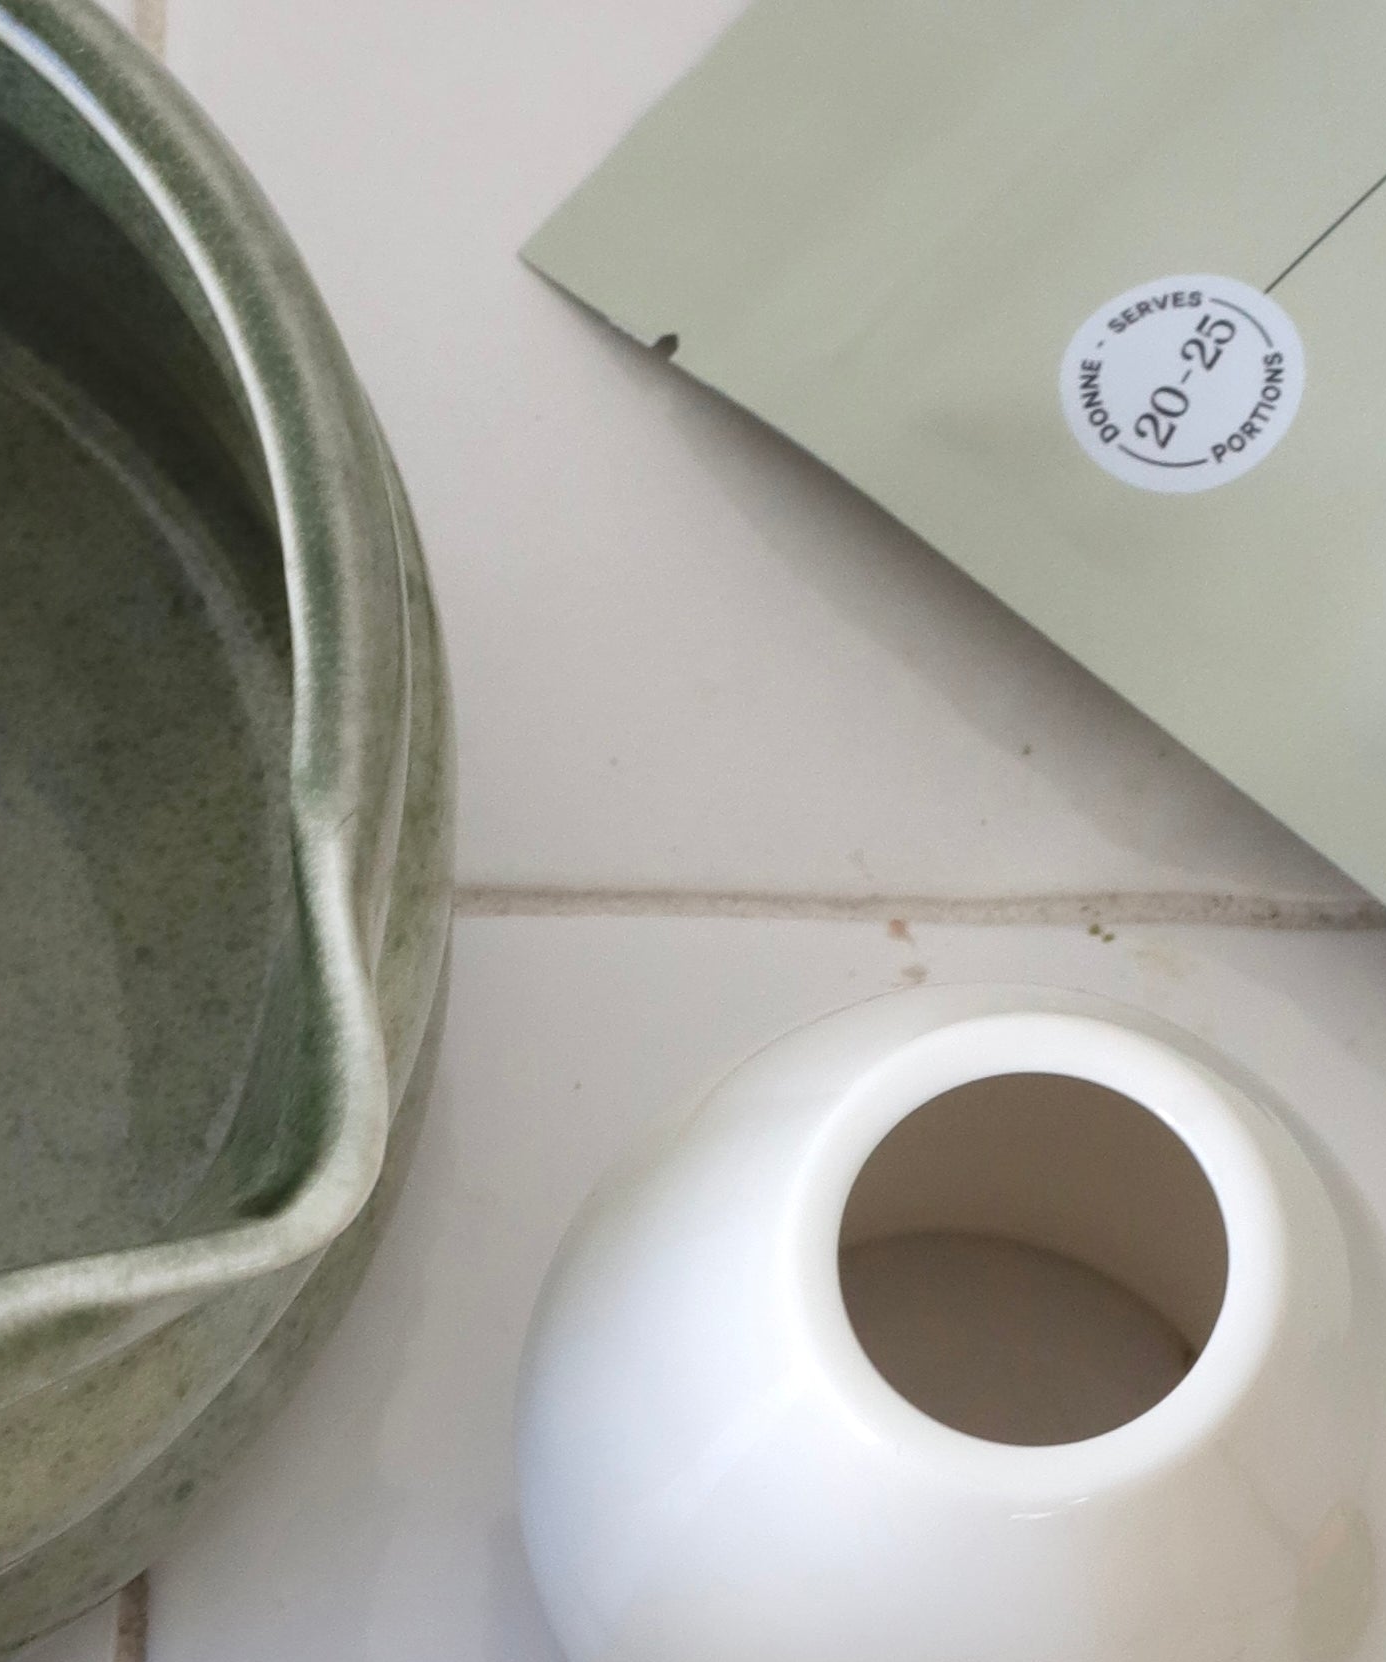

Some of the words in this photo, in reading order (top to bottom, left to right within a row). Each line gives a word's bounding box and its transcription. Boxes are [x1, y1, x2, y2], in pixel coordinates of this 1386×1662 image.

[1078, 358, 1121, 444] DONNE
[1107, 290, 1203, 334] SERVES
[1133, 313, 1237, 449] 20-25
[1210, 351, 1284, 464] PORTIONS
